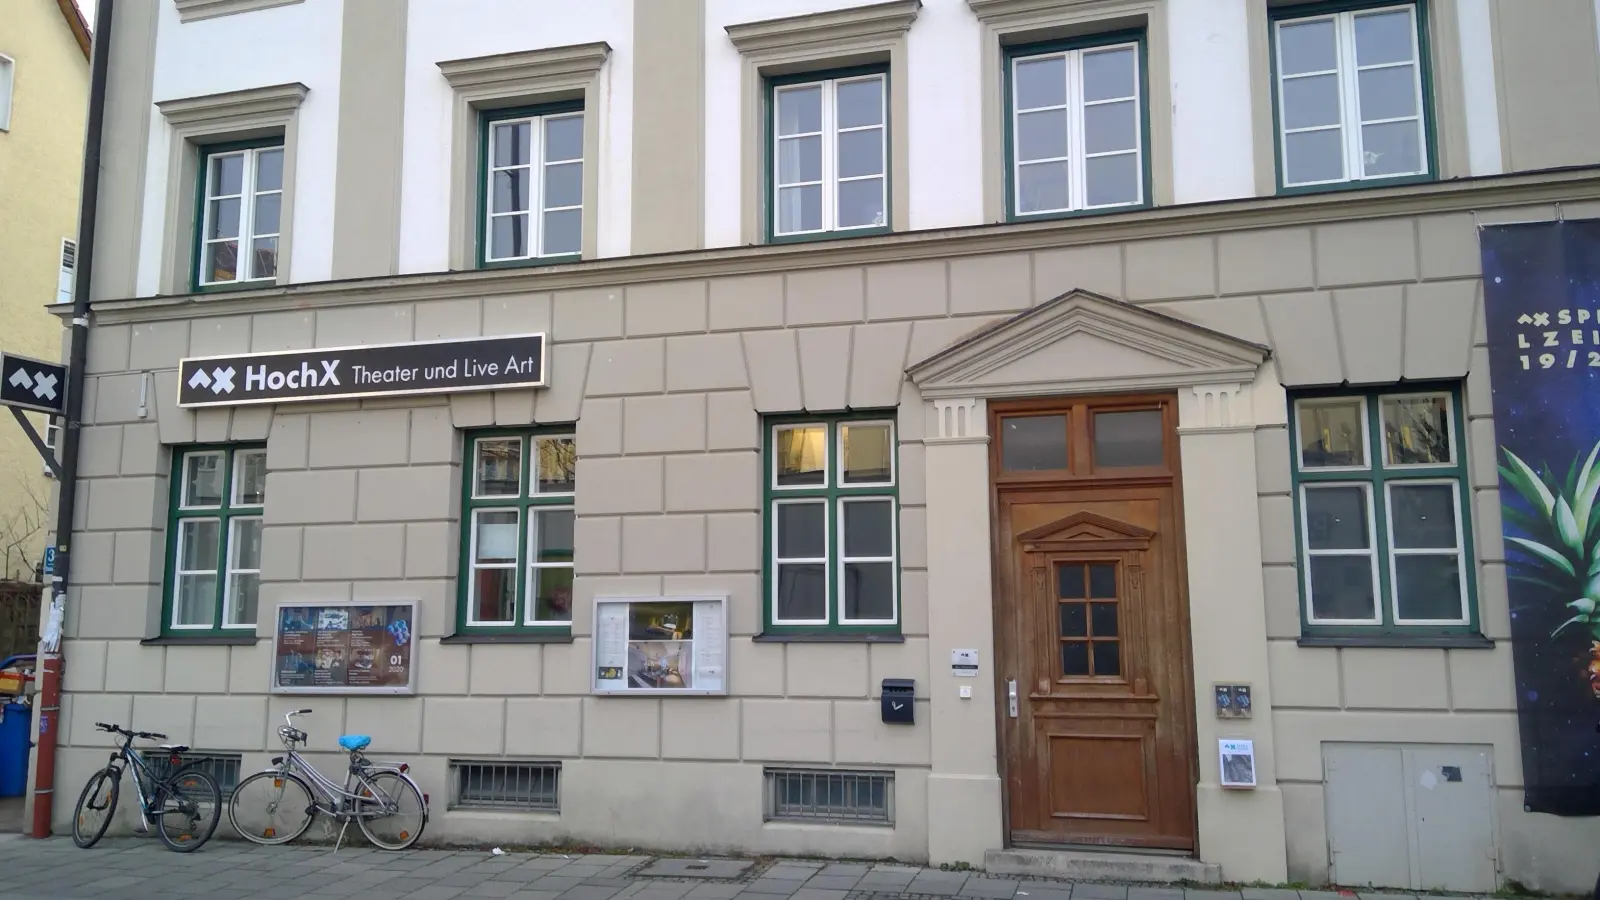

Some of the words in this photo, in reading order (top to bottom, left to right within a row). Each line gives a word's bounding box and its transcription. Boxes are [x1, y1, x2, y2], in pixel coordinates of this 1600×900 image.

[245, 359, 341, 392] HochX
[351, 365, 419, 385] Theater
[424, 359, 458, 380] und
[464, 358, 499, 377] Live
[504, 355, 534, 375] Art
[390, 655, 402, 665] 01
